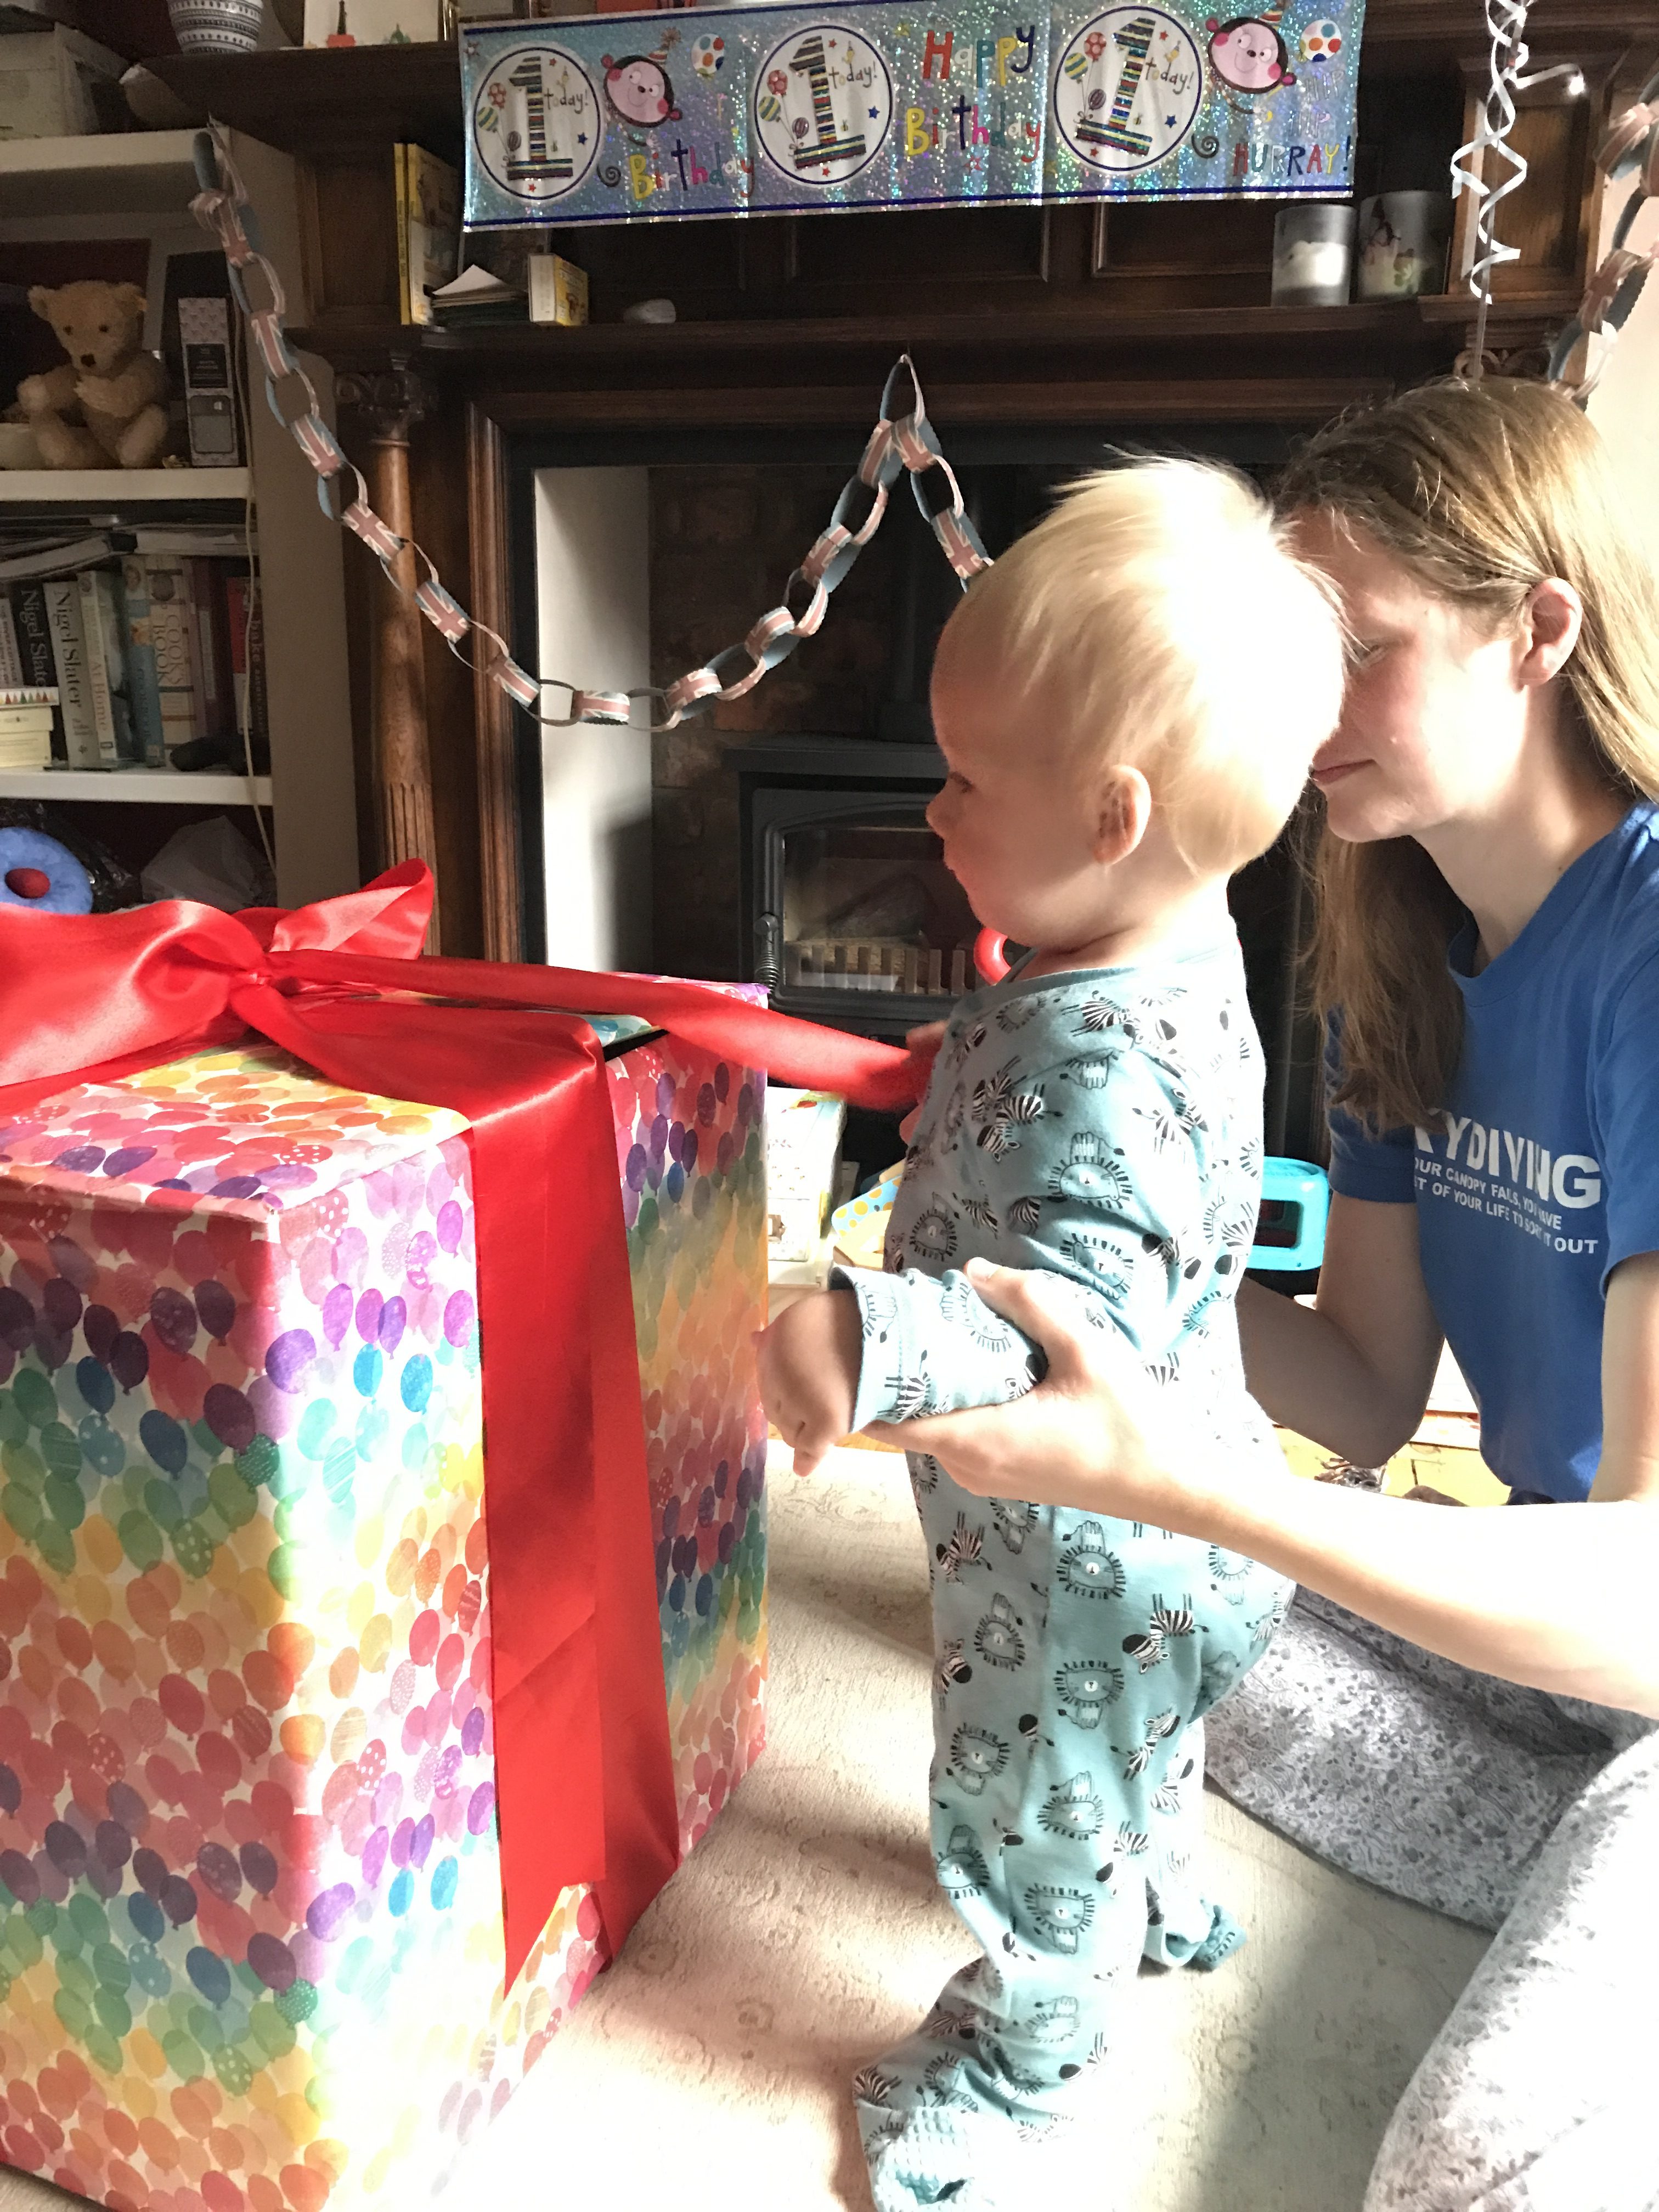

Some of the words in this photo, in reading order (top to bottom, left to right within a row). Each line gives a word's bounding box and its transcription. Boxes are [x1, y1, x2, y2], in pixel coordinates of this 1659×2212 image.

[922, 25, 1036, 88] Happy
[1075, 17, 1156, 156] 1
[1145, 57, 1194, 95] today!
[508, 57, 573, 180] 1
[543, 85, 589, 114] today!
[789, 35, 866, 170] 1
[828, 60, 878, 89] today!
[907, 95, 1042, 163] Birthday
[629, 139, 755, 200] Birthday
[1233, 135, 1351, 176] HURRAY!
[19, 590, 44, 637] Nigel
[54, 591, 79, 643] Nigel
[31, 643, 48, 686] Slate
[63, 648, 81, 708] Slater
[153, 625, 170, 686] BOOK
[166, 614, 184, 685] COOK'S
[1415, 1108, 1601, 1209] YDIVING
[1446, 1167, 1486, 1194] CANOPY
[1432, 1182, 1451, 1198] OF
[1454, 1189, 1483, 1212] YOUR
[1486, 1201, 1510, 1221] LIFE
[1512, 1210, 1523, 1228] TO
[1554, 1237, 1599, 1254] OUT
